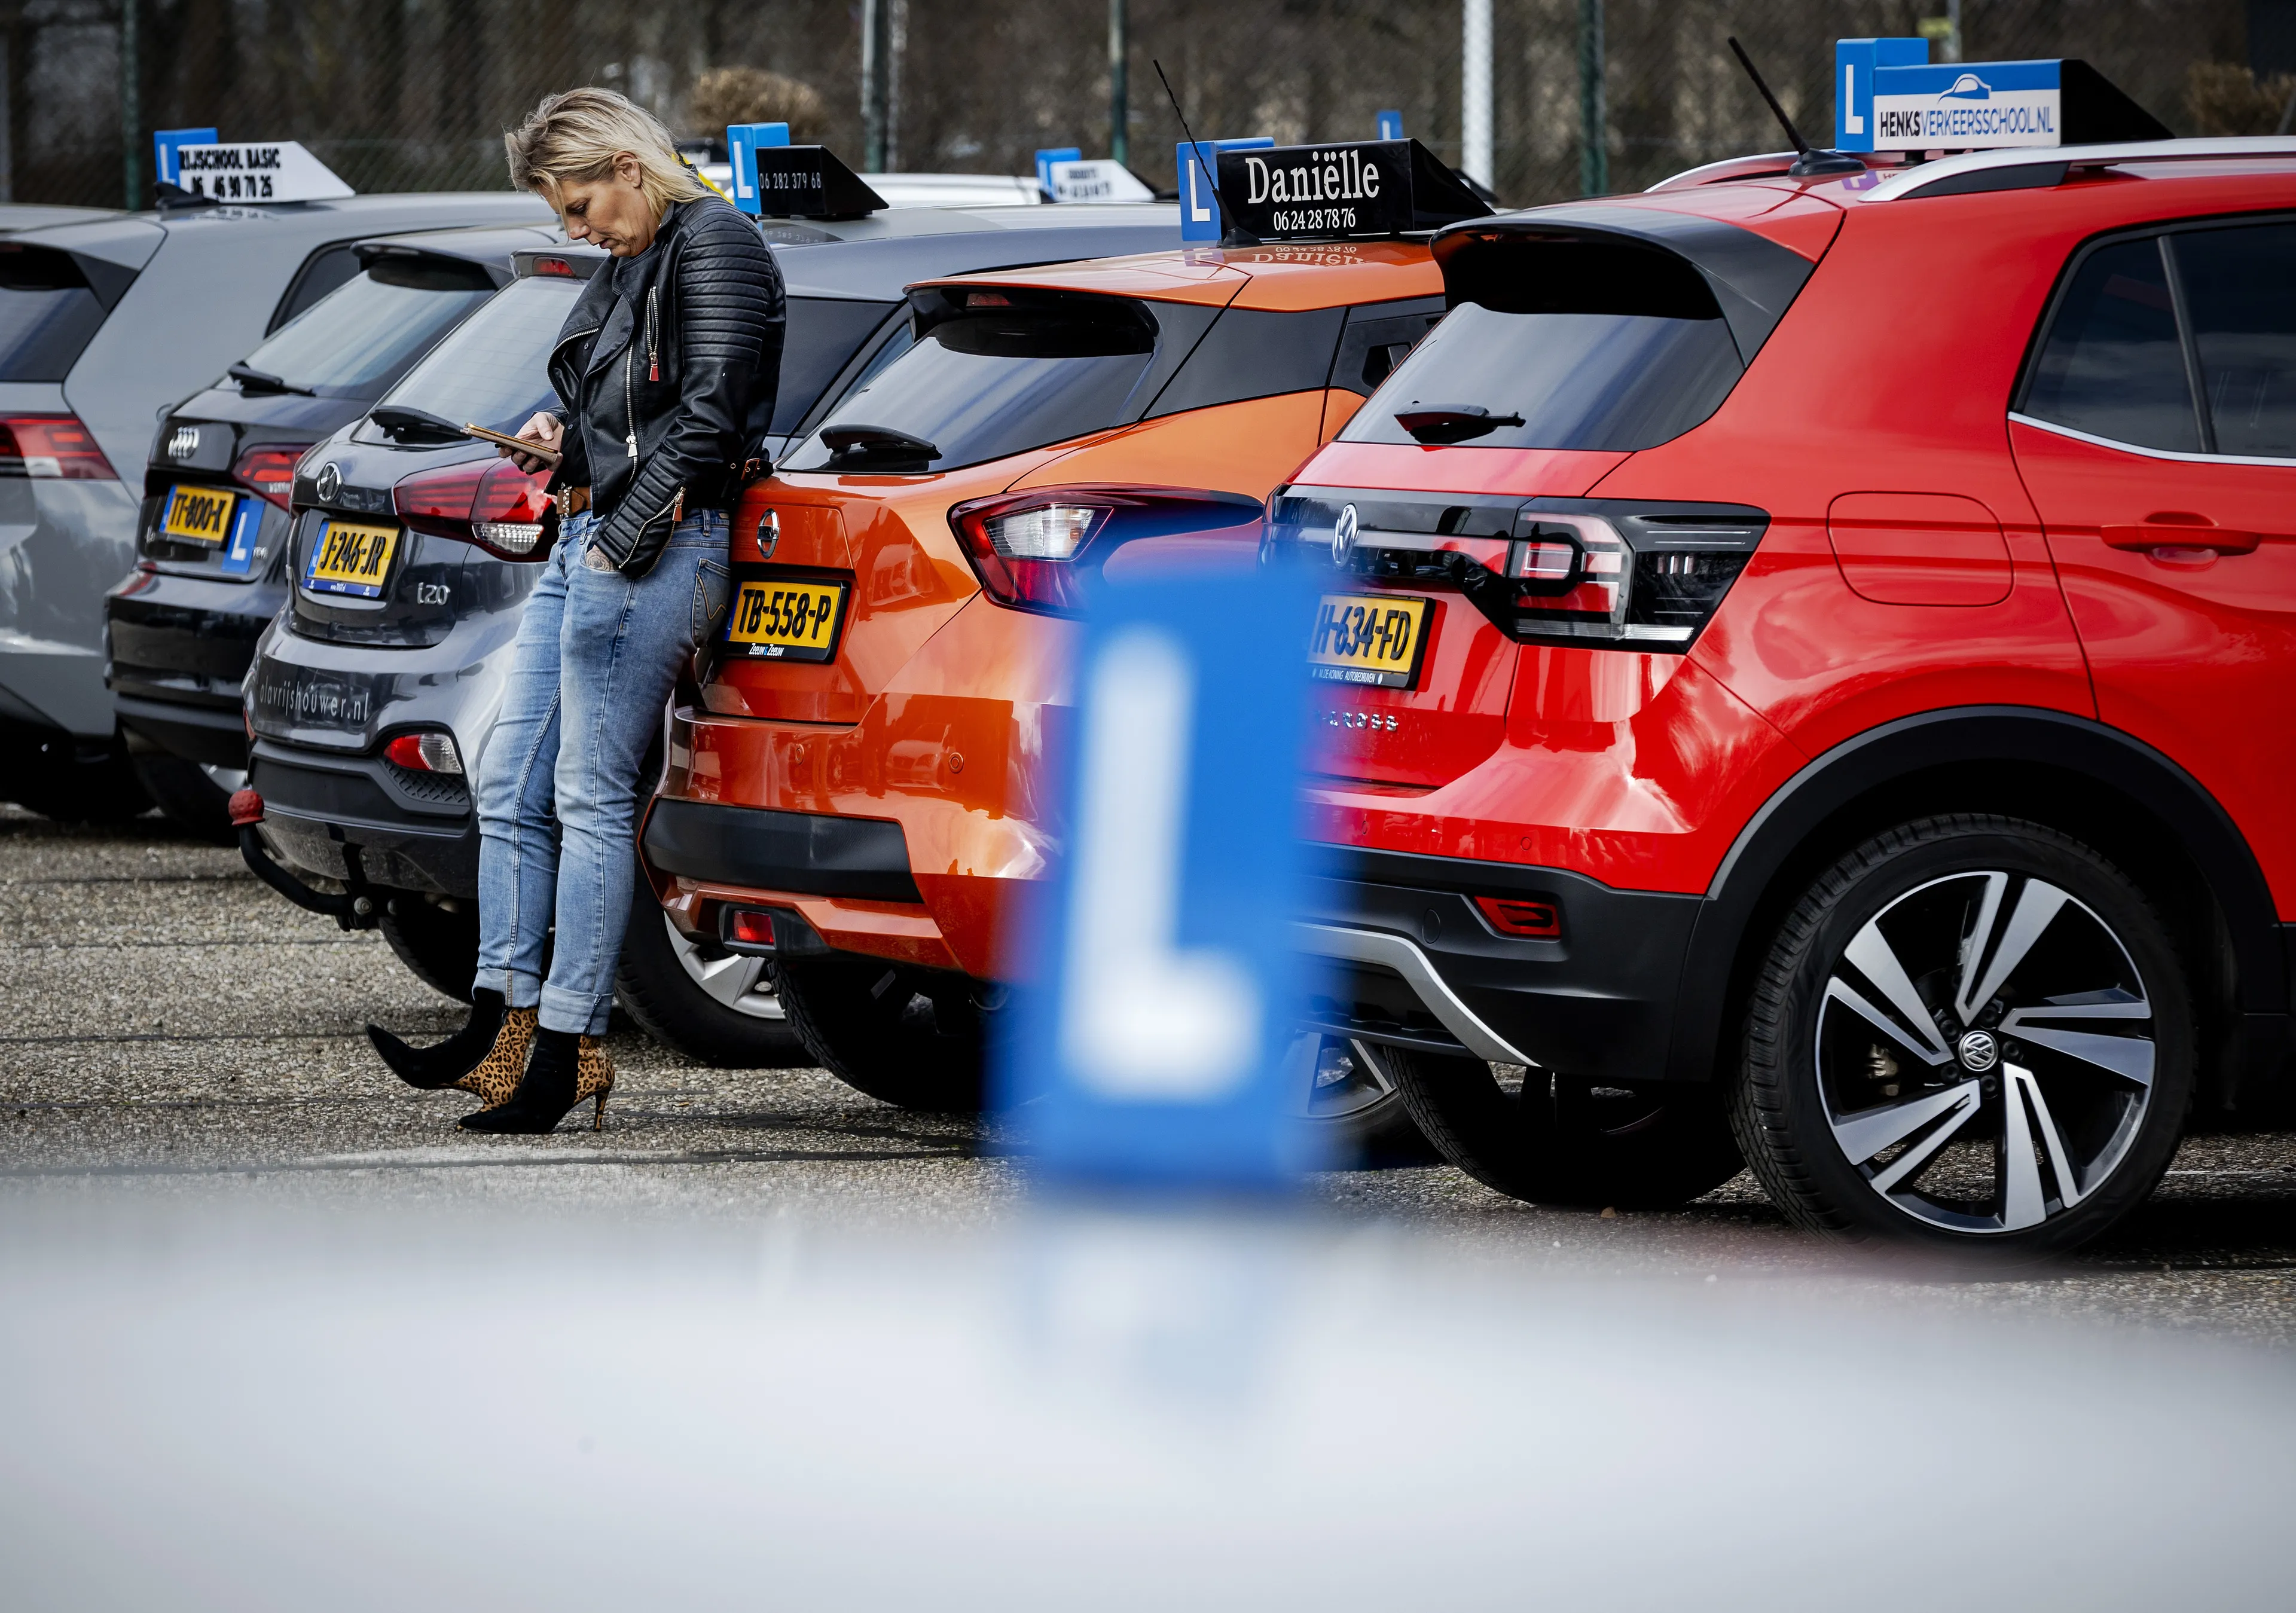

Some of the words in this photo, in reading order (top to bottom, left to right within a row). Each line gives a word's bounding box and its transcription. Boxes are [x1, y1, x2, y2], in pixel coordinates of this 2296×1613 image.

[1845, 64, 1864, 134] L
[1880, 106, 2054, 138] HENKSVERKEERSSCHOOL.NL
[246, 148, 280, 169] BASIC
[733, 140, 753, 199] L
[759, 173, 770, 190] 06
[773, 172, 789, 189] 282
[792, 172, 807, 189] 379
[811, 172, 822, 189] 68
[1245, 149, 1379, 204] Daniëlle
[1188, 159, 1210, 222] L
[1274, 210, 1289, 231] 06
[1291, 210, 1306, 230] 24
[1308, 209, 1323, 229] 28
[1324, 208, 1340, 228] 78
[1341, 207, 1355, 228] 76
[231, 512, 247, 561] L
[320, 531, 386, 576] J-246-JR
[417, 582, 450, 606] i20
[738, 589, 831, 640] TB-558-P
[1312, 604, 1411, 661] H-634-FD
[1063, 623, 1263, 1103] L
